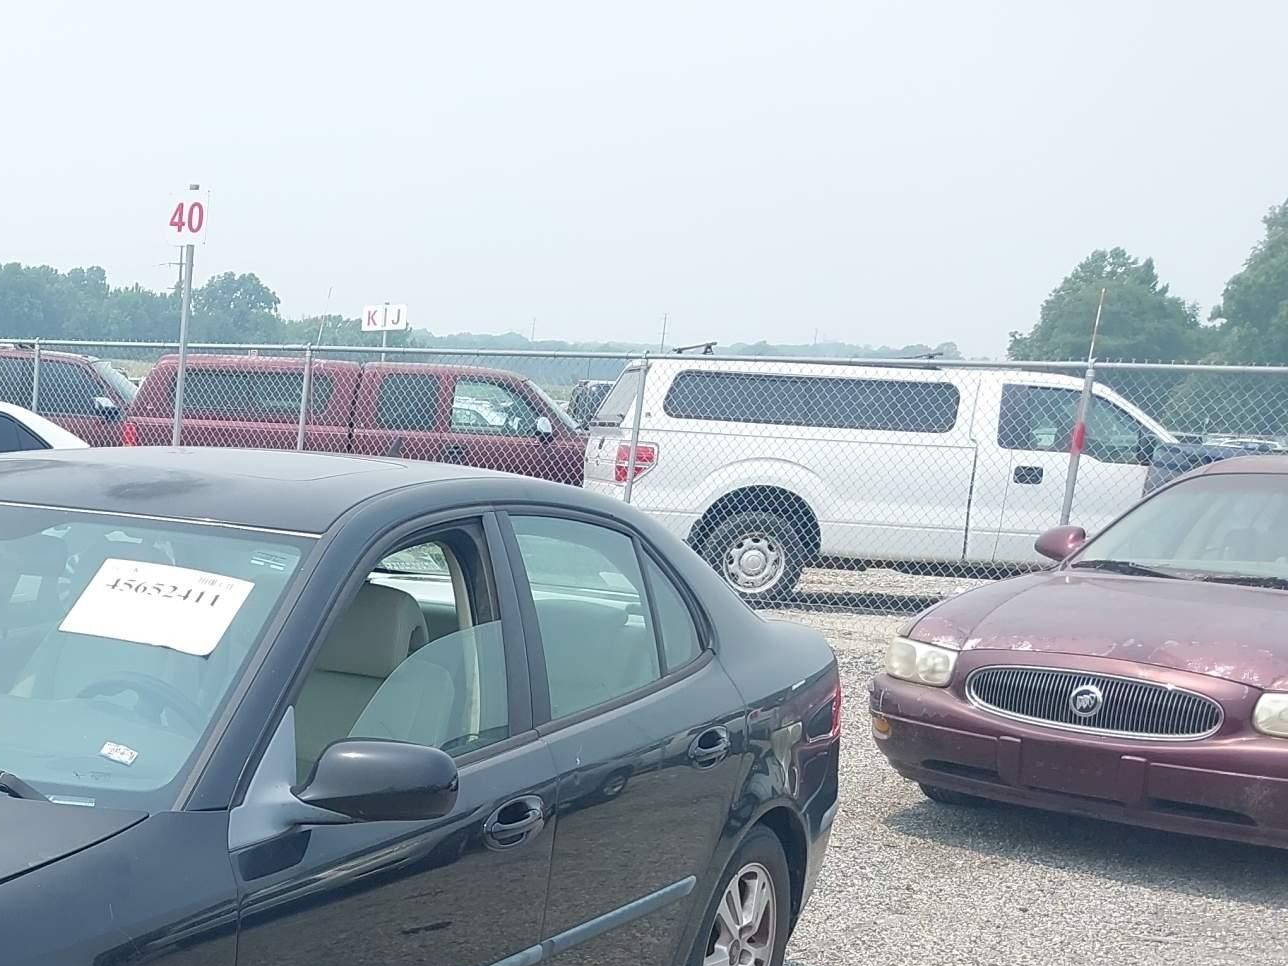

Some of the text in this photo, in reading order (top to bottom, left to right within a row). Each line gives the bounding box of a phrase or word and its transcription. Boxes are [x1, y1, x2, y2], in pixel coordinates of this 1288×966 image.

[169, 202, 204, 233] 40
[367, 309, 401, 326] K J
[106, 577, 220, 607] 45652411
